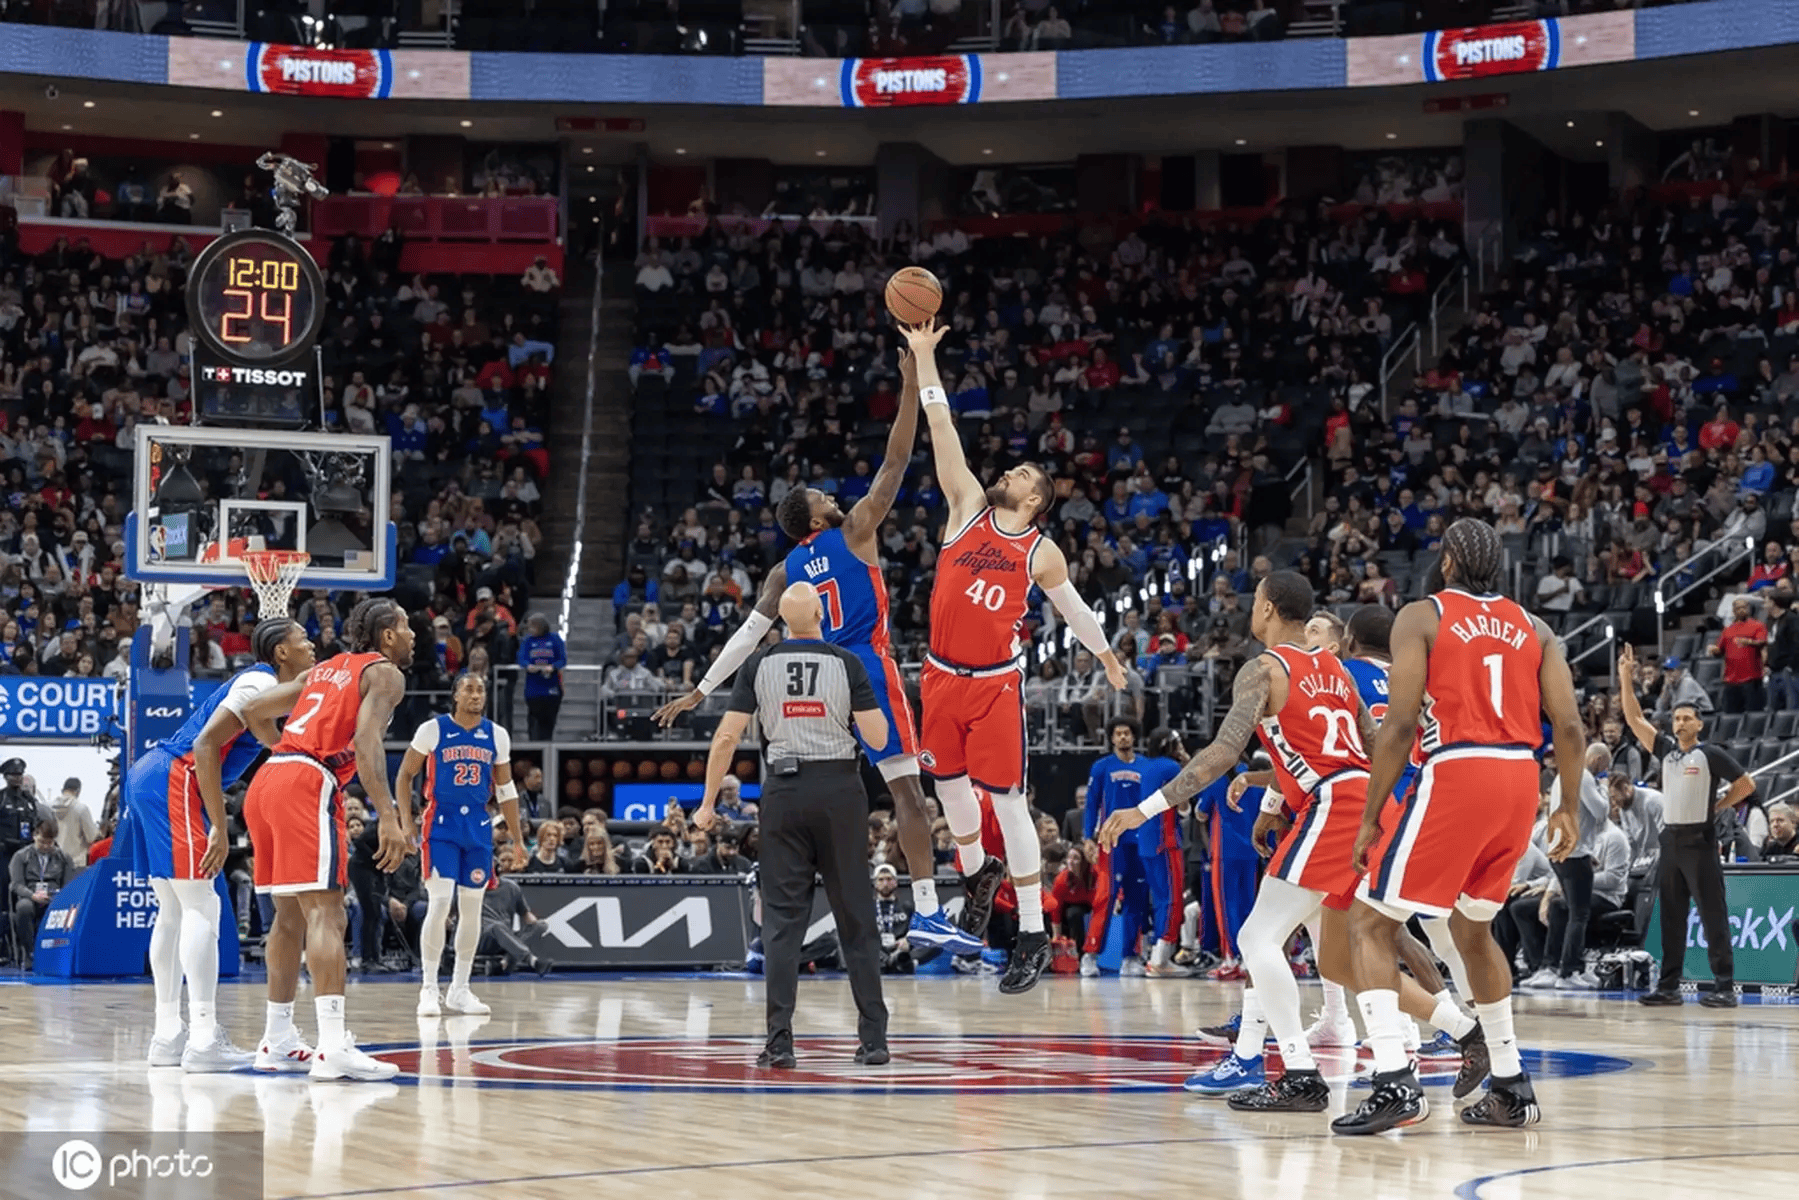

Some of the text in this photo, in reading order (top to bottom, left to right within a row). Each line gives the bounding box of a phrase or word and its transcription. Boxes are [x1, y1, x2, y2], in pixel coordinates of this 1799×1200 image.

[1457, 34, 1526, 65] PISTONS
[283, 58, 357, 85] PISTONS
[876, 68, 947, 94] PISTONS
[229, 257, 298, 290] 12:00
[221, 289, 291, 345] 24
[232, 368, 307, 387] TISSOT
[974, 541, 1003, 558] Los
[804, 556, 830, 579] REED
[953, 551, 1017, 576] Angeles
[965, 577, 1006, 612] 40
[1450, 614, 1528, 650] HARDEN
[786, 661, 820, 697] 37
[1483, 653, 1504, 719] 1
[17, 682, 119, 709] COURT
[16, 708, 100, 733] CLUB
[146, 707, 182, 717] KIA
[284, 692, 325, 735] 2
[1308, 705, 1368, 760] 20
[442, 745, 493, 764] DETROIT
[454, 763, 481, 786] 23
[513, 897, 712, 949] KIA
